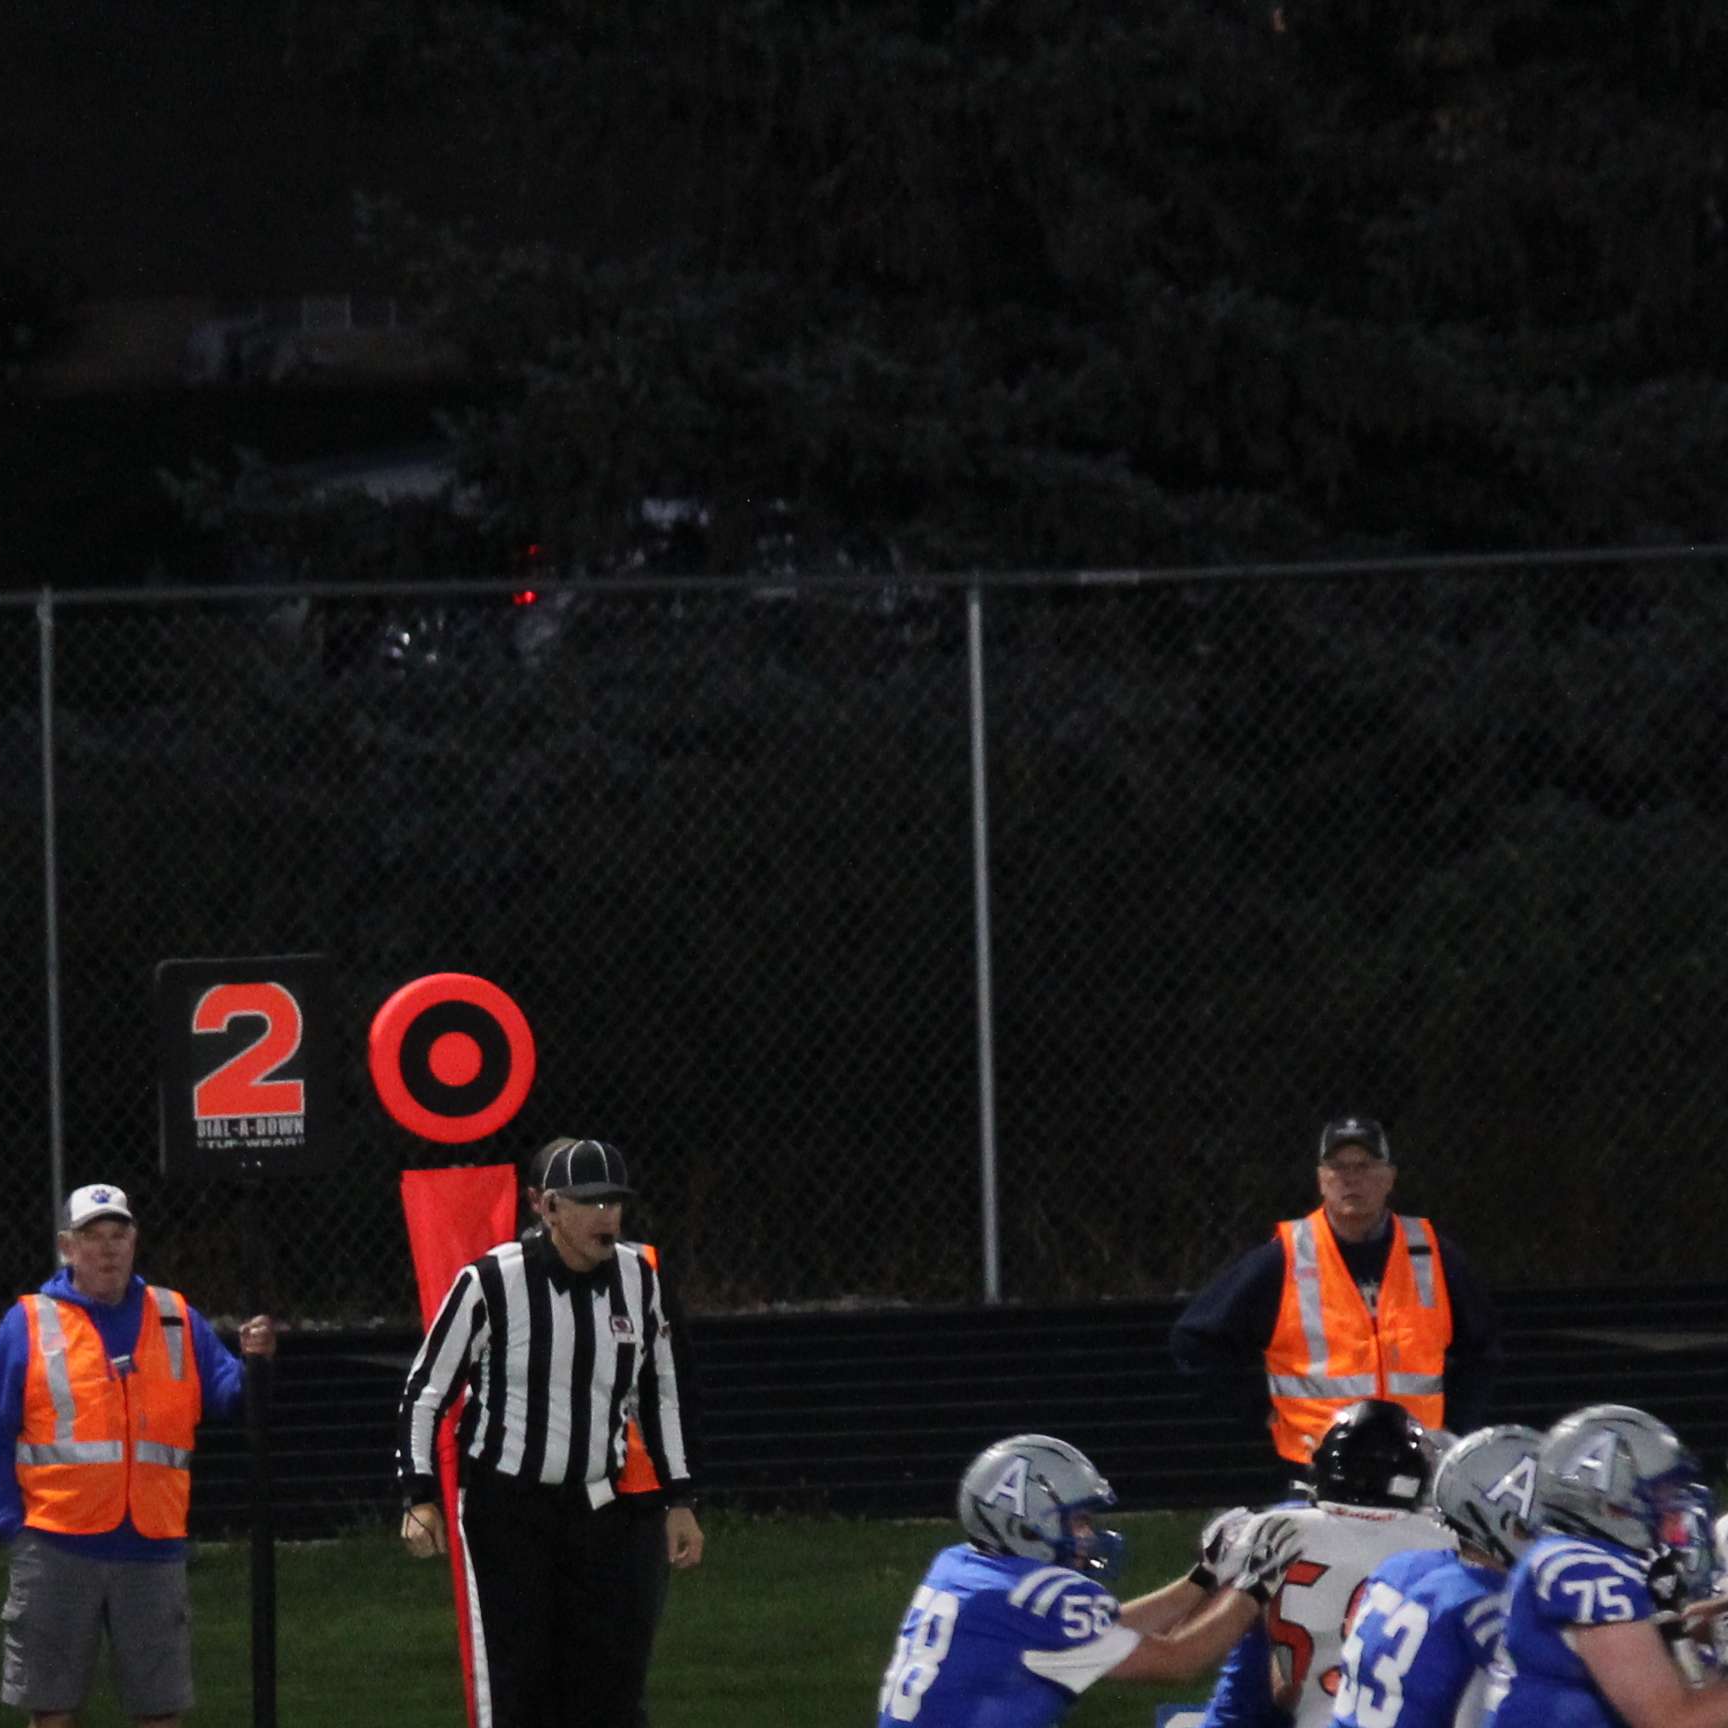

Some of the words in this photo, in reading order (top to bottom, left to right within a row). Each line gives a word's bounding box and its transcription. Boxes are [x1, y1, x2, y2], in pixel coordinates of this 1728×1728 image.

[192, 982, 304, 1120] 2
[984, 1454, 1033, 1518] A
[1484, 1454, 1538, 1521] A
[1562, 1576, 1635, 1624] 75
[878, 1584, 960, 1722] 58
